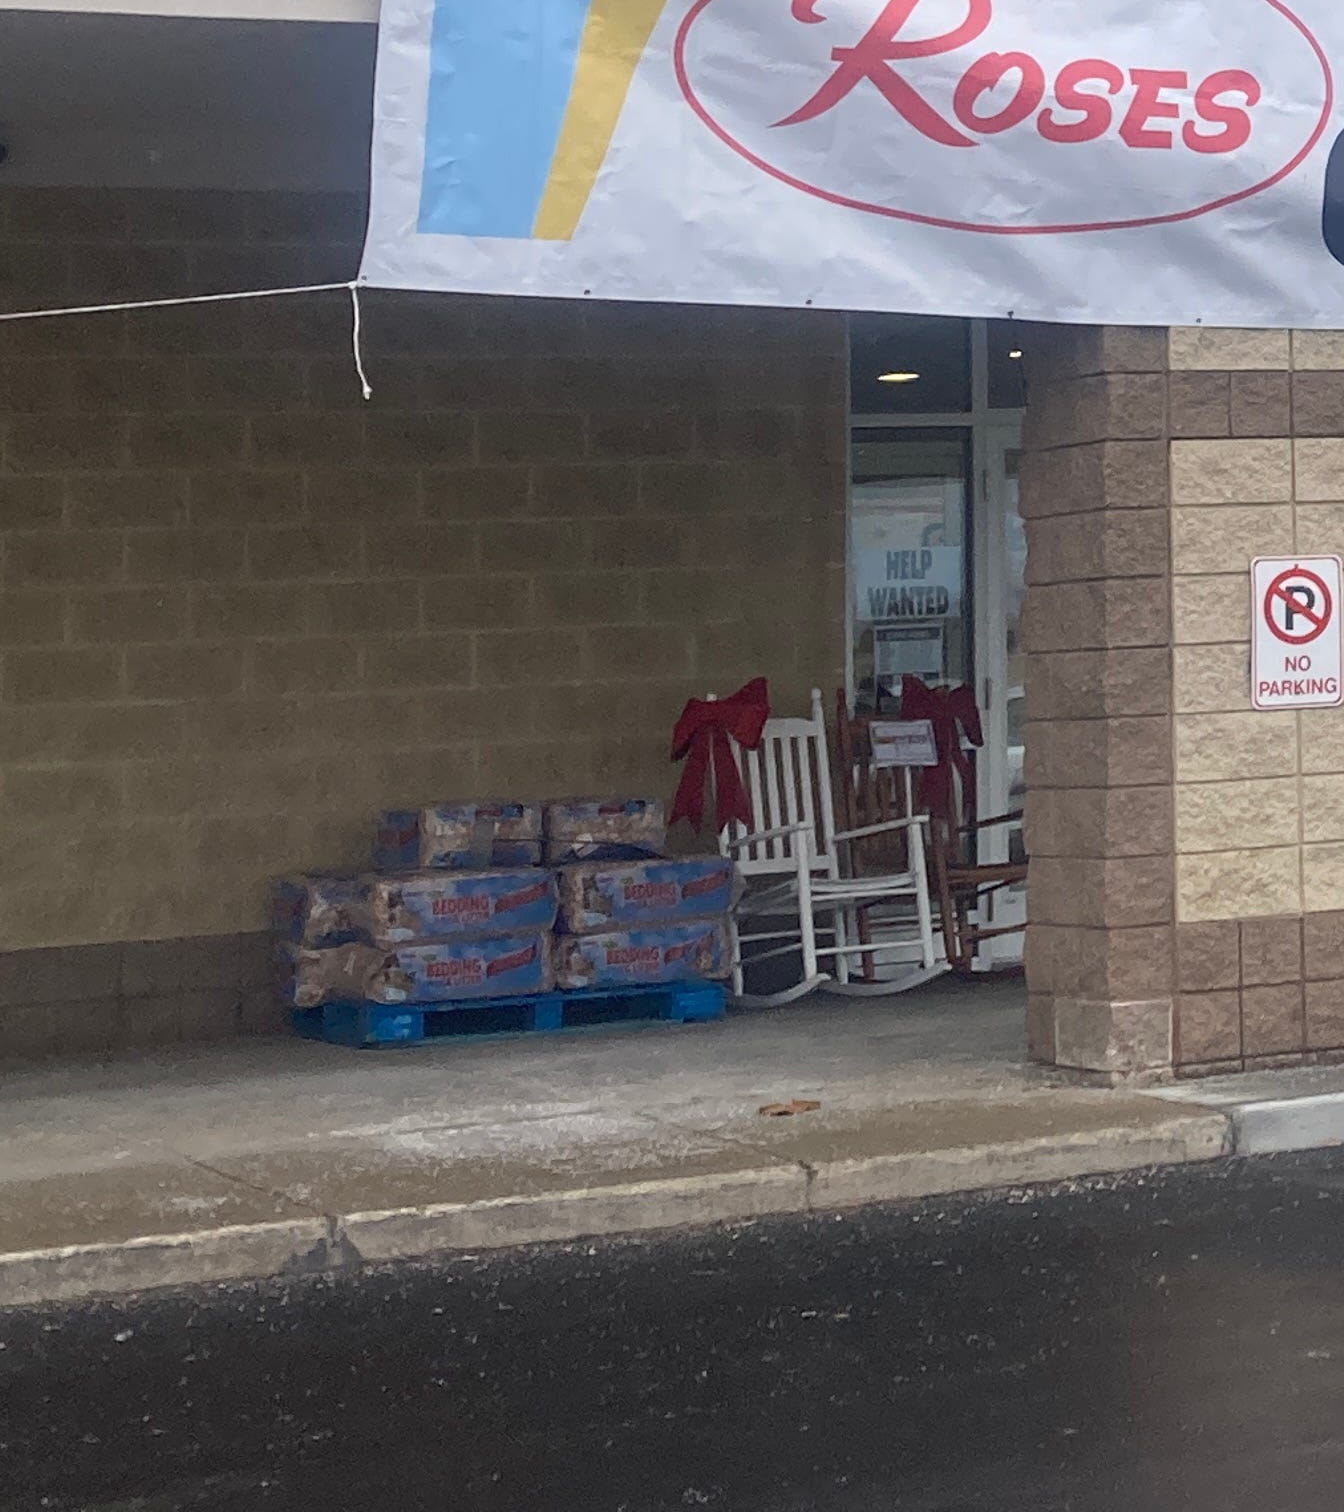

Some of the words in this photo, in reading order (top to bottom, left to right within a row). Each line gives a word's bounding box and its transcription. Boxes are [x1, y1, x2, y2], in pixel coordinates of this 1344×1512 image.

[886, 549, 932, 581] HELP
[867, 584, 950, 617] WANTED
[1284, 655, 1312, 672] NO
[1259, 677, 1338, 697] PARKING
